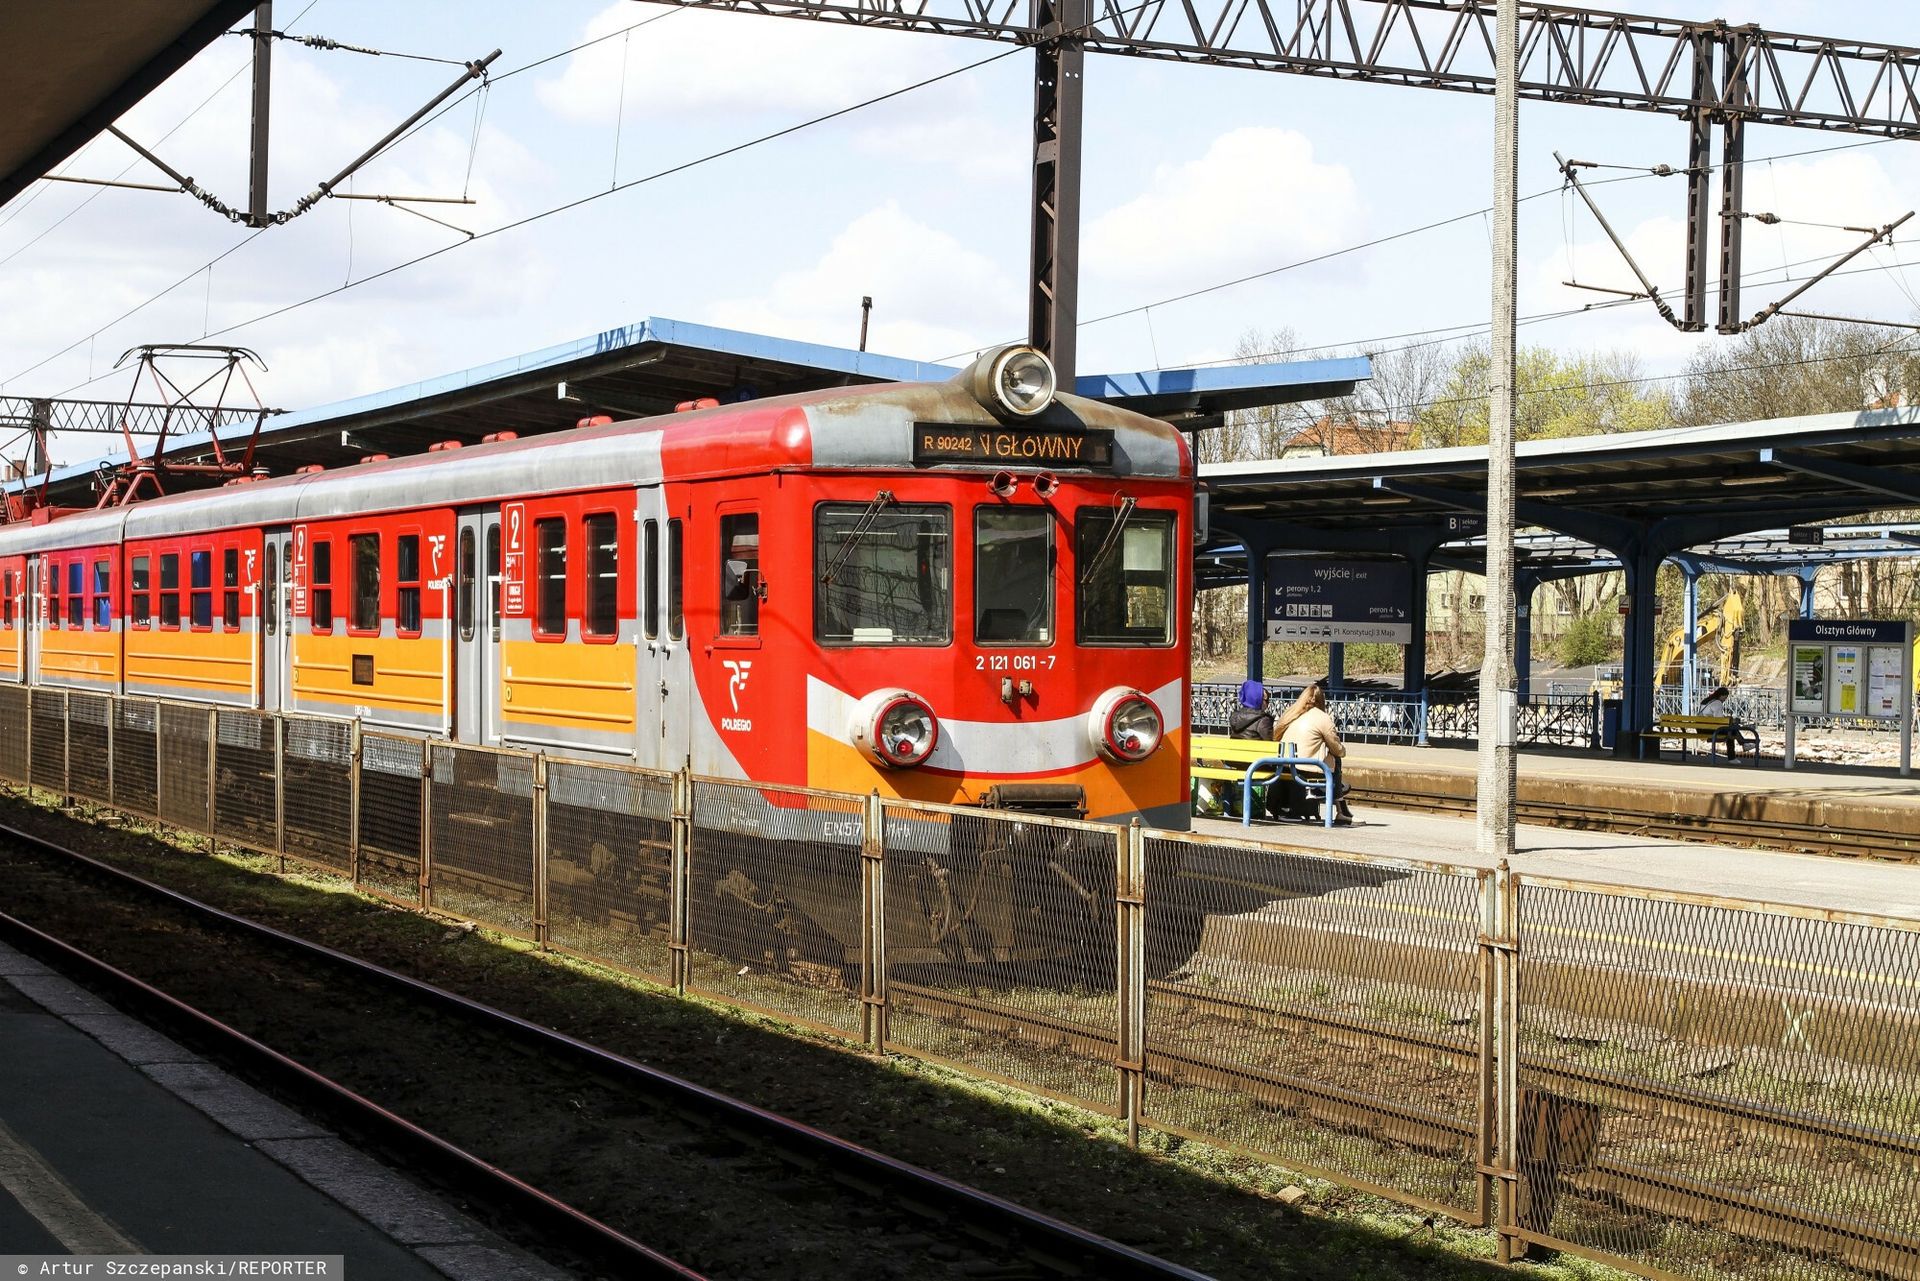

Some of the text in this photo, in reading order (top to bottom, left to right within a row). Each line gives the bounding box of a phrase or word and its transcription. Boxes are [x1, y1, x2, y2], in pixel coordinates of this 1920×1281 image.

[924, 436, 934, 450] R
[995, 434, 1083, 459] GŁÓWNY
[510, 509, 520, 549] 2
[1449, 517, 1457, 530] B
[1813, 531, 1820, 543] B
[297, 530, 304, 562] 2
[1314, 567, 1351, 581] wyjście
[1286, 585, 1309, 594] perony
[1316, 585, 1322, 593] 2
[1369, 606, 1394, 615] peron 4
[1381, 629, 1396, 638] Maja
[1815, 624, 1877, 638] Olsztyn Główny
[975, 655, 985, 670] 2
[989, 655, 1008, 670] 121
[1013, 655, 1036, 670] 061
[721, 717, 752, 732] POLREGIO
